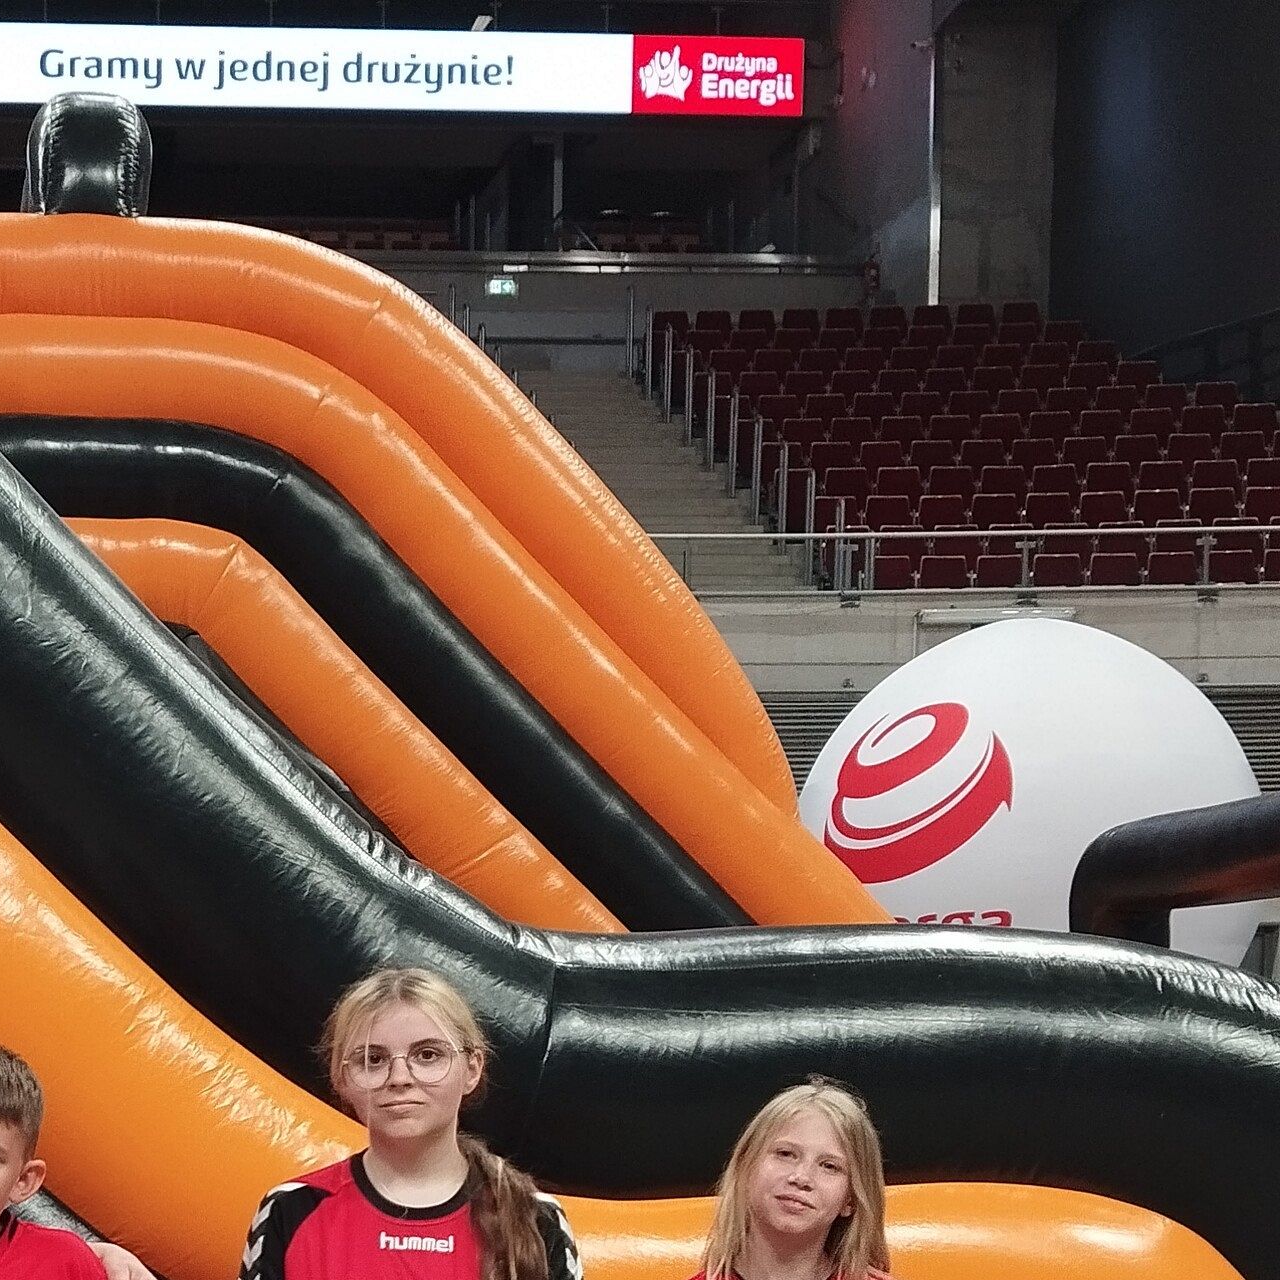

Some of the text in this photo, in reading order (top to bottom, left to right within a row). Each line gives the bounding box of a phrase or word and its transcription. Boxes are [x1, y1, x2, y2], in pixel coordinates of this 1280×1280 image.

[39, 49, 514, 94] Gramy w jednej drużynie!
[702, 52, 778, 77] Drużyna
[701, 73, 795, 107] Energii
[379, 1231, 455, 1253] hummel
